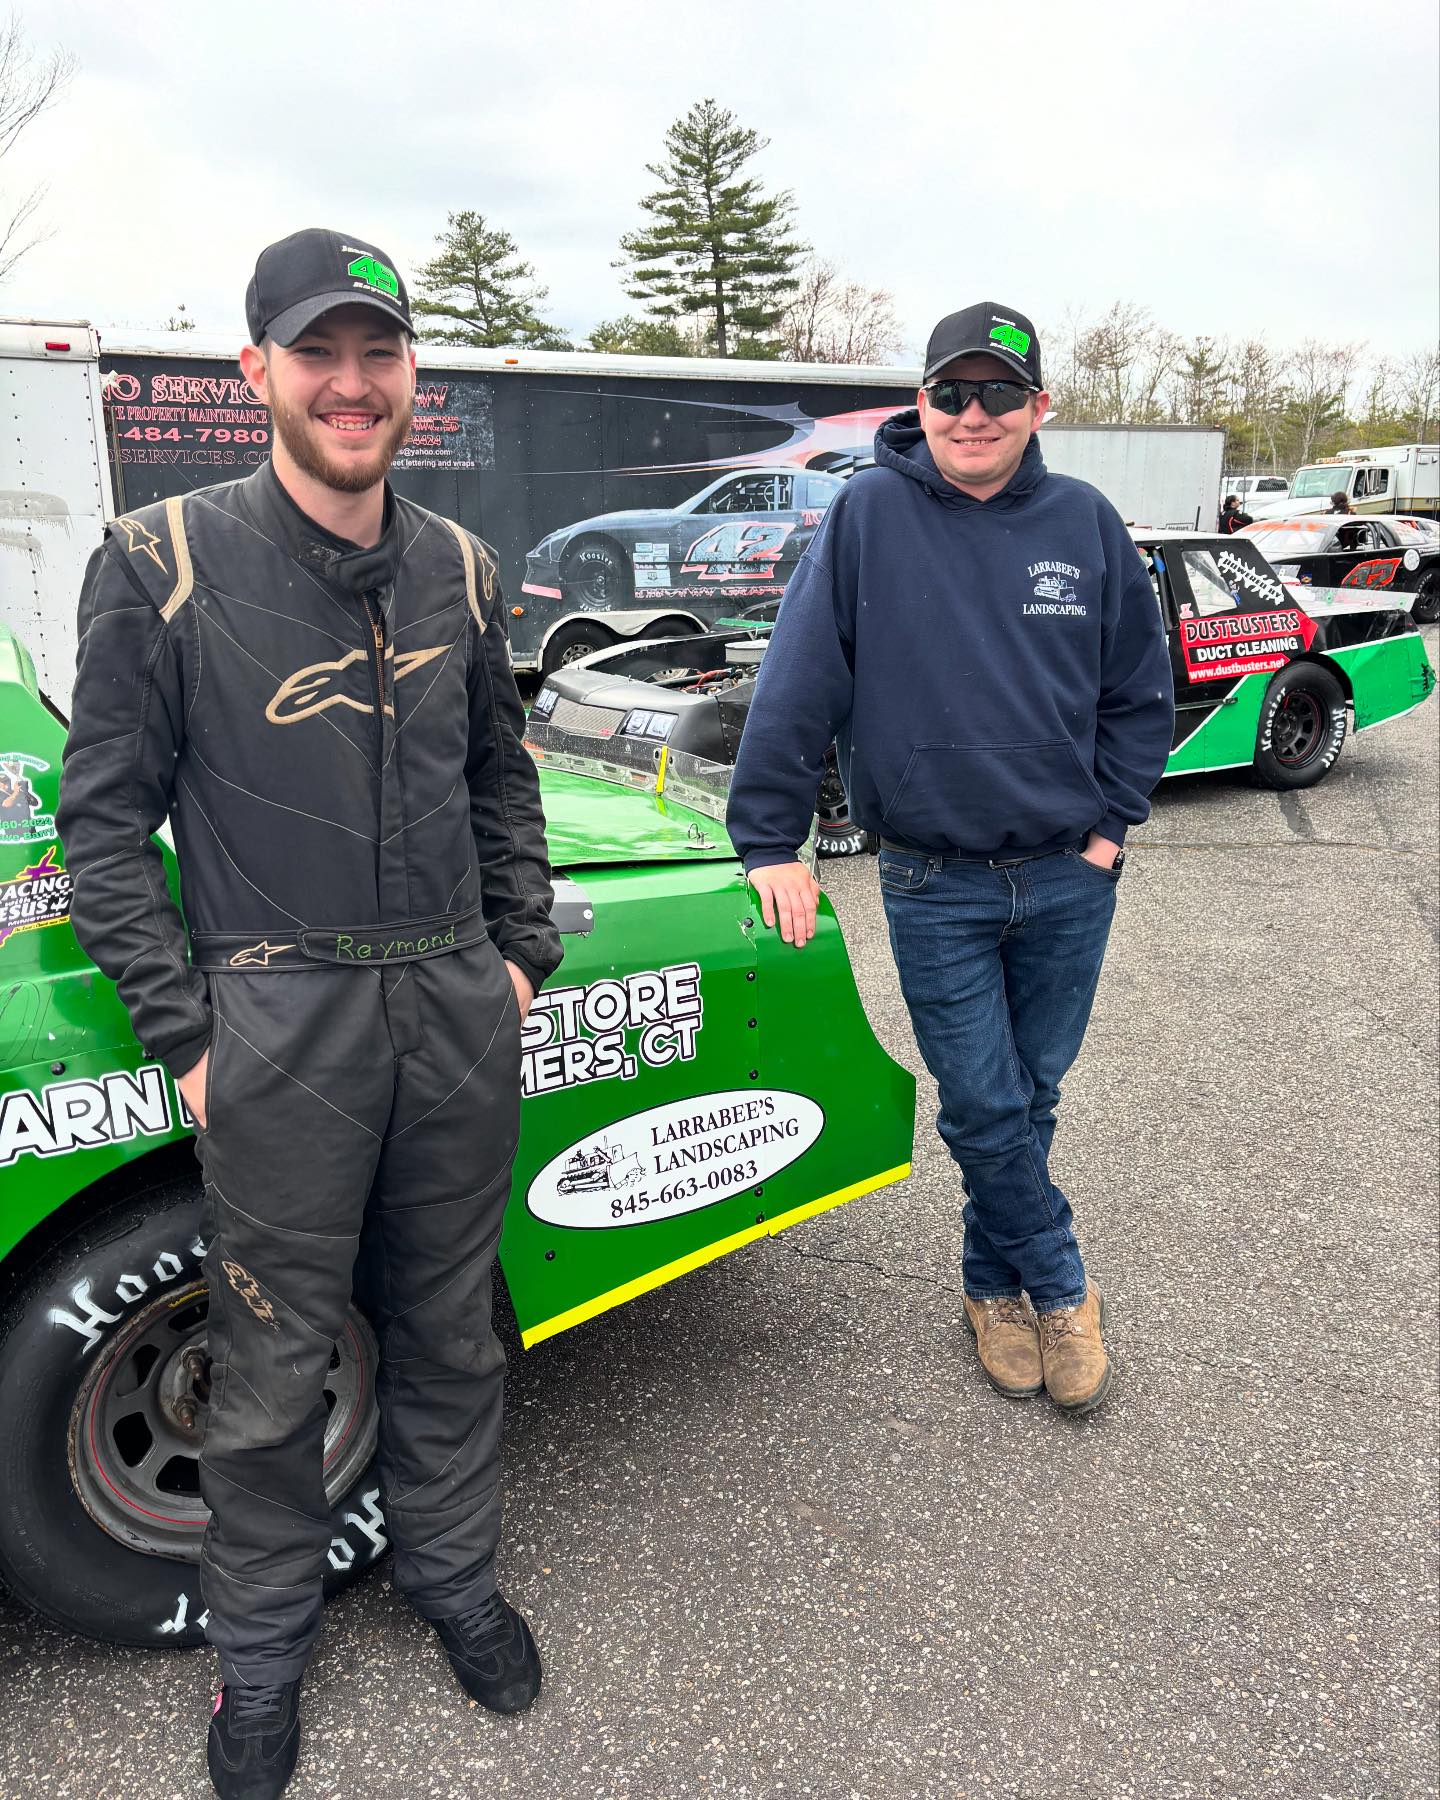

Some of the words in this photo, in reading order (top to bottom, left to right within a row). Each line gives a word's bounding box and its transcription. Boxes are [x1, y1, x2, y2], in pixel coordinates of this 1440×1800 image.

[127, 407, 187, 422] PROPERTY
[188, 409, 268, 424] MAINTENANCE
[453, 460, 475, 468] wraps
[679, 521, 797, 582] 42
[1027, 561, 1081, 580] LARRABEE'S
[1223, 558, 1267, 590] POWERED
[1022, 603, 1087, 616] LANDSCAPING
[1186, 612, 1300, 643] DUSTBUSTERS
[1196, 644, 1233, 662] DUCT
[1235, 637, 1299, 657] CLEANING
[1189, 658, 1285, 680] www.dustbusters.net
[1322, 707, 1347, 769] Hoosier
[0, 816, 53, 829] 60-2024
[0, 874, 71, 902] ACING
[0, 898, 49, 922] ESUS
[336, 926, 456, 960] Raymond
[640, 1015, 702, 1066] CT
[651, 1096, 776, 1147] LARRABEE'S
[655, 1118, 800, 1174] LANDSCAPING
[611, 1160, 758, 1218] 845-663-0083
